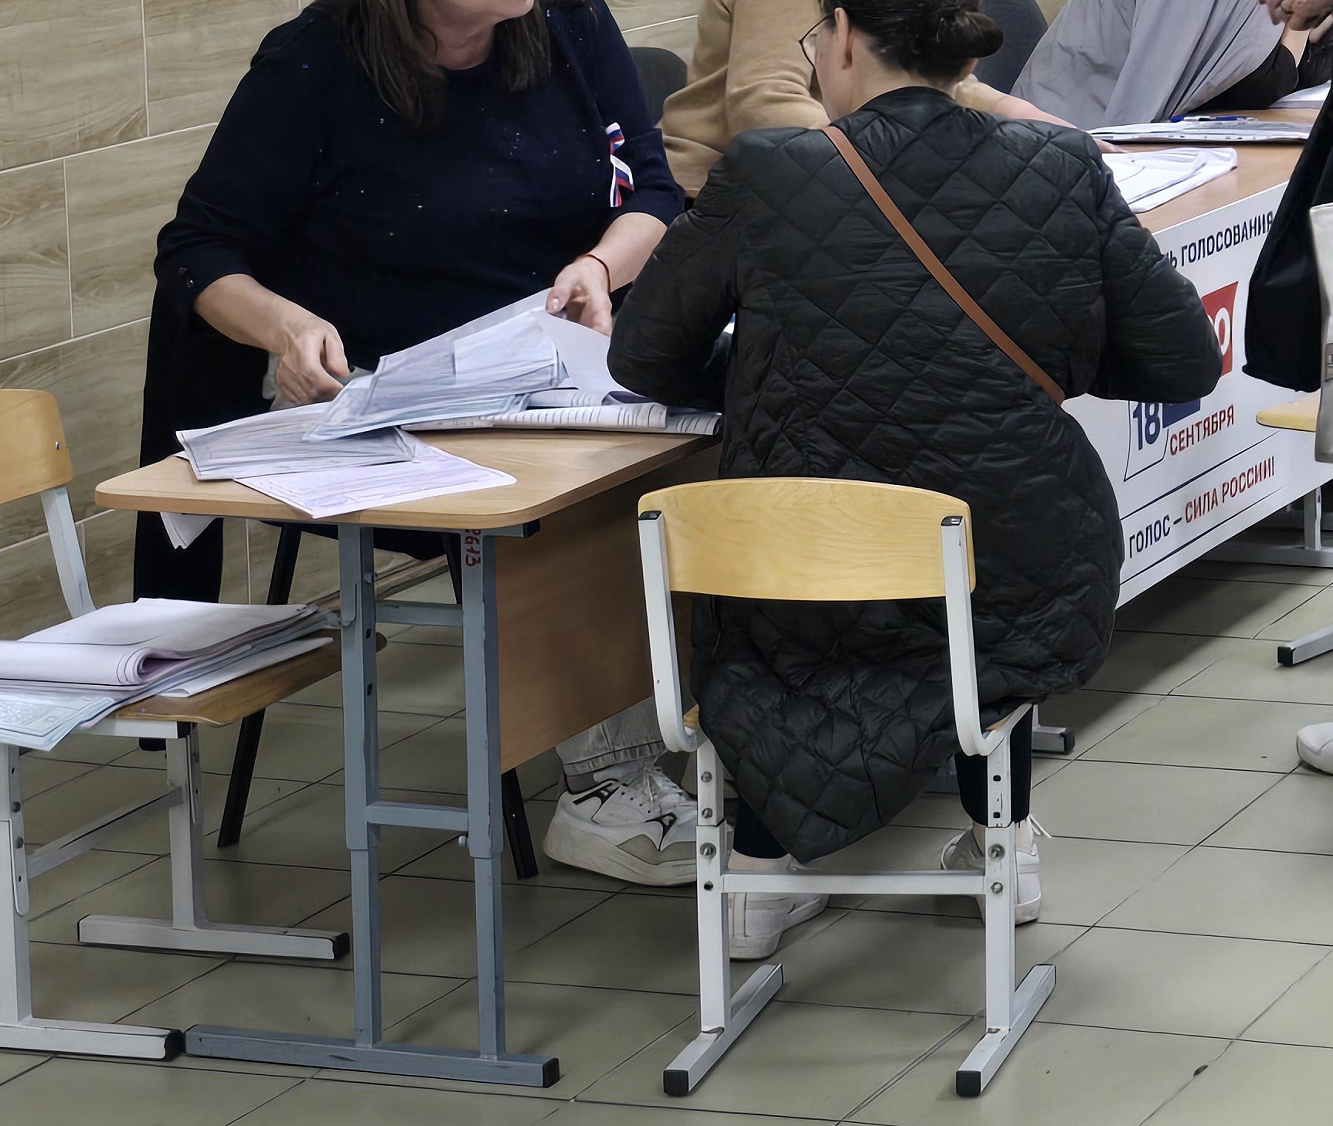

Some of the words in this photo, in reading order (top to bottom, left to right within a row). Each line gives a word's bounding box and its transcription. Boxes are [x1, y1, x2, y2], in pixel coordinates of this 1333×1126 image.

[1181, 211, 1274, 267] ГОЛОСОВАНИЯ
[1132, 401, 1160, 451] 18
[1169, 404, 1235, 456] СЕНТЯБРЯ
[1129, 514, 1171, 558] ГОЛОС
[1185, 487, 1218, 524] СИЛА
[1222, 456, 1275, 503] РОССИИ!
